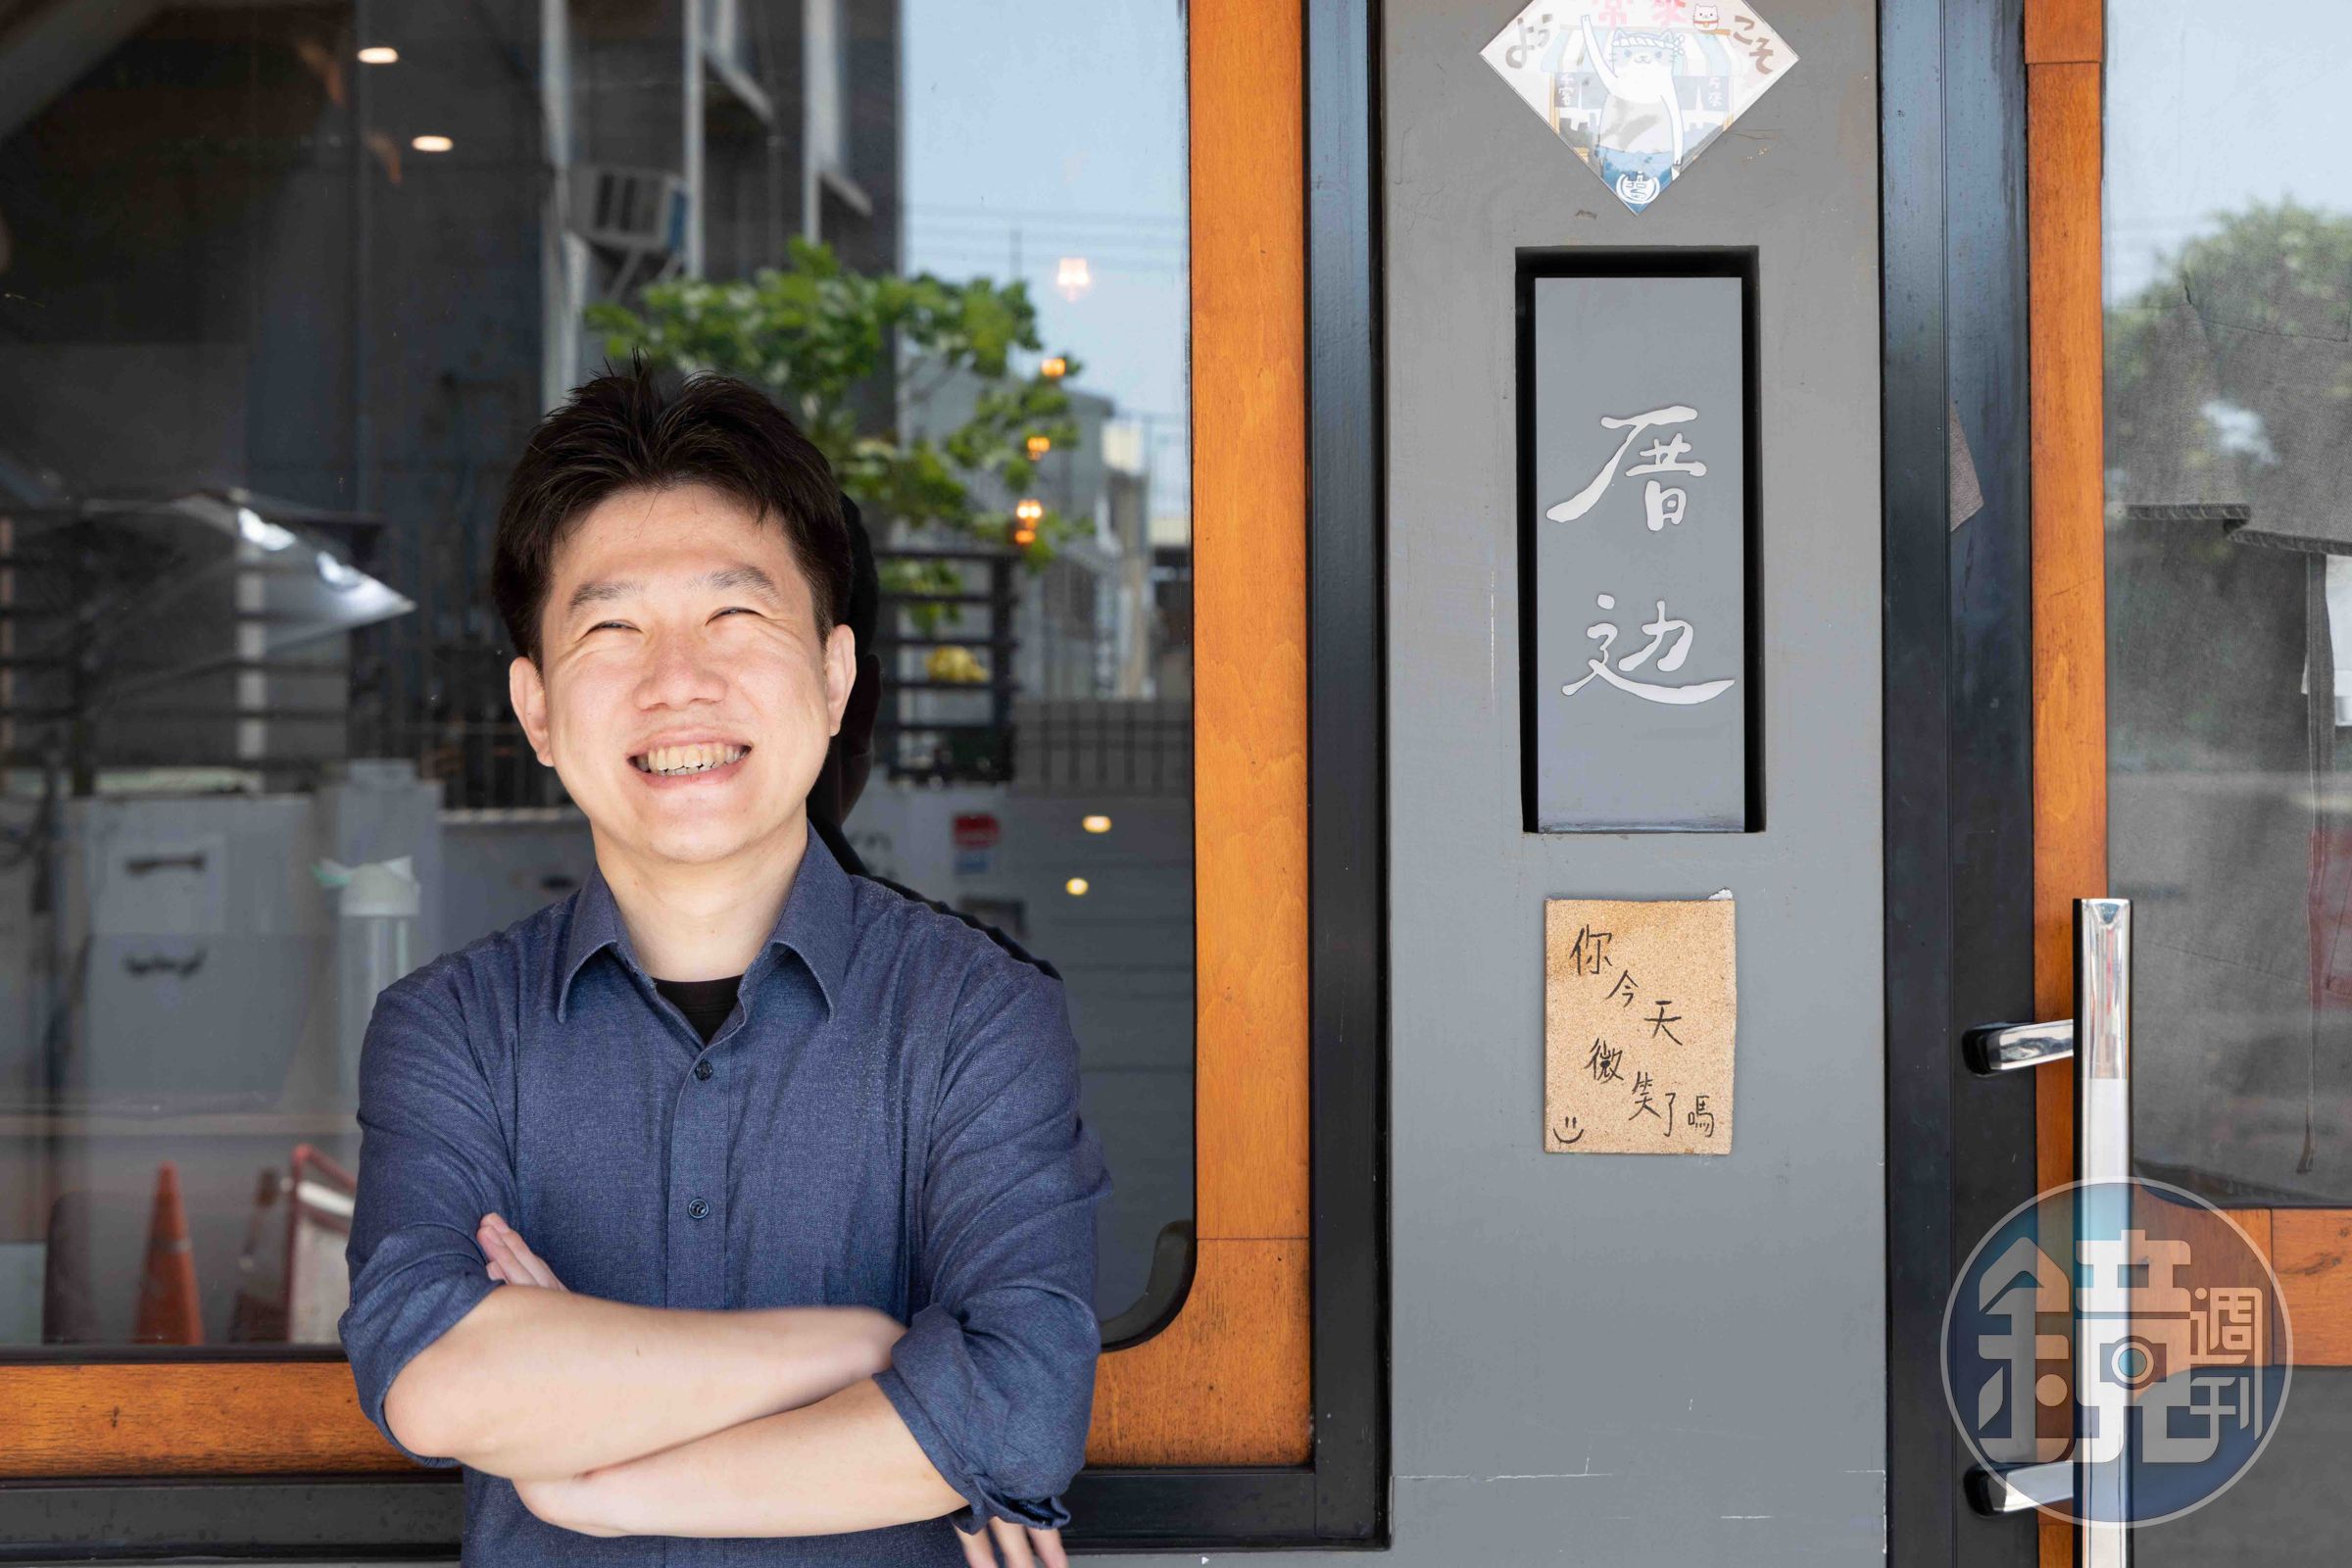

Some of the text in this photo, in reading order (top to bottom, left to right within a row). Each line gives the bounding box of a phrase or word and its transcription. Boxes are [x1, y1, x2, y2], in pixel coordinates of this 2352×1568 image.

[1505, 14, 1552, 69] よう
[1734, 15, 1774, 74] こそ
[1569, 924, 1683, 1046] 你今天
[1584, 1037, 1715, 1138] 微笑了嗎
